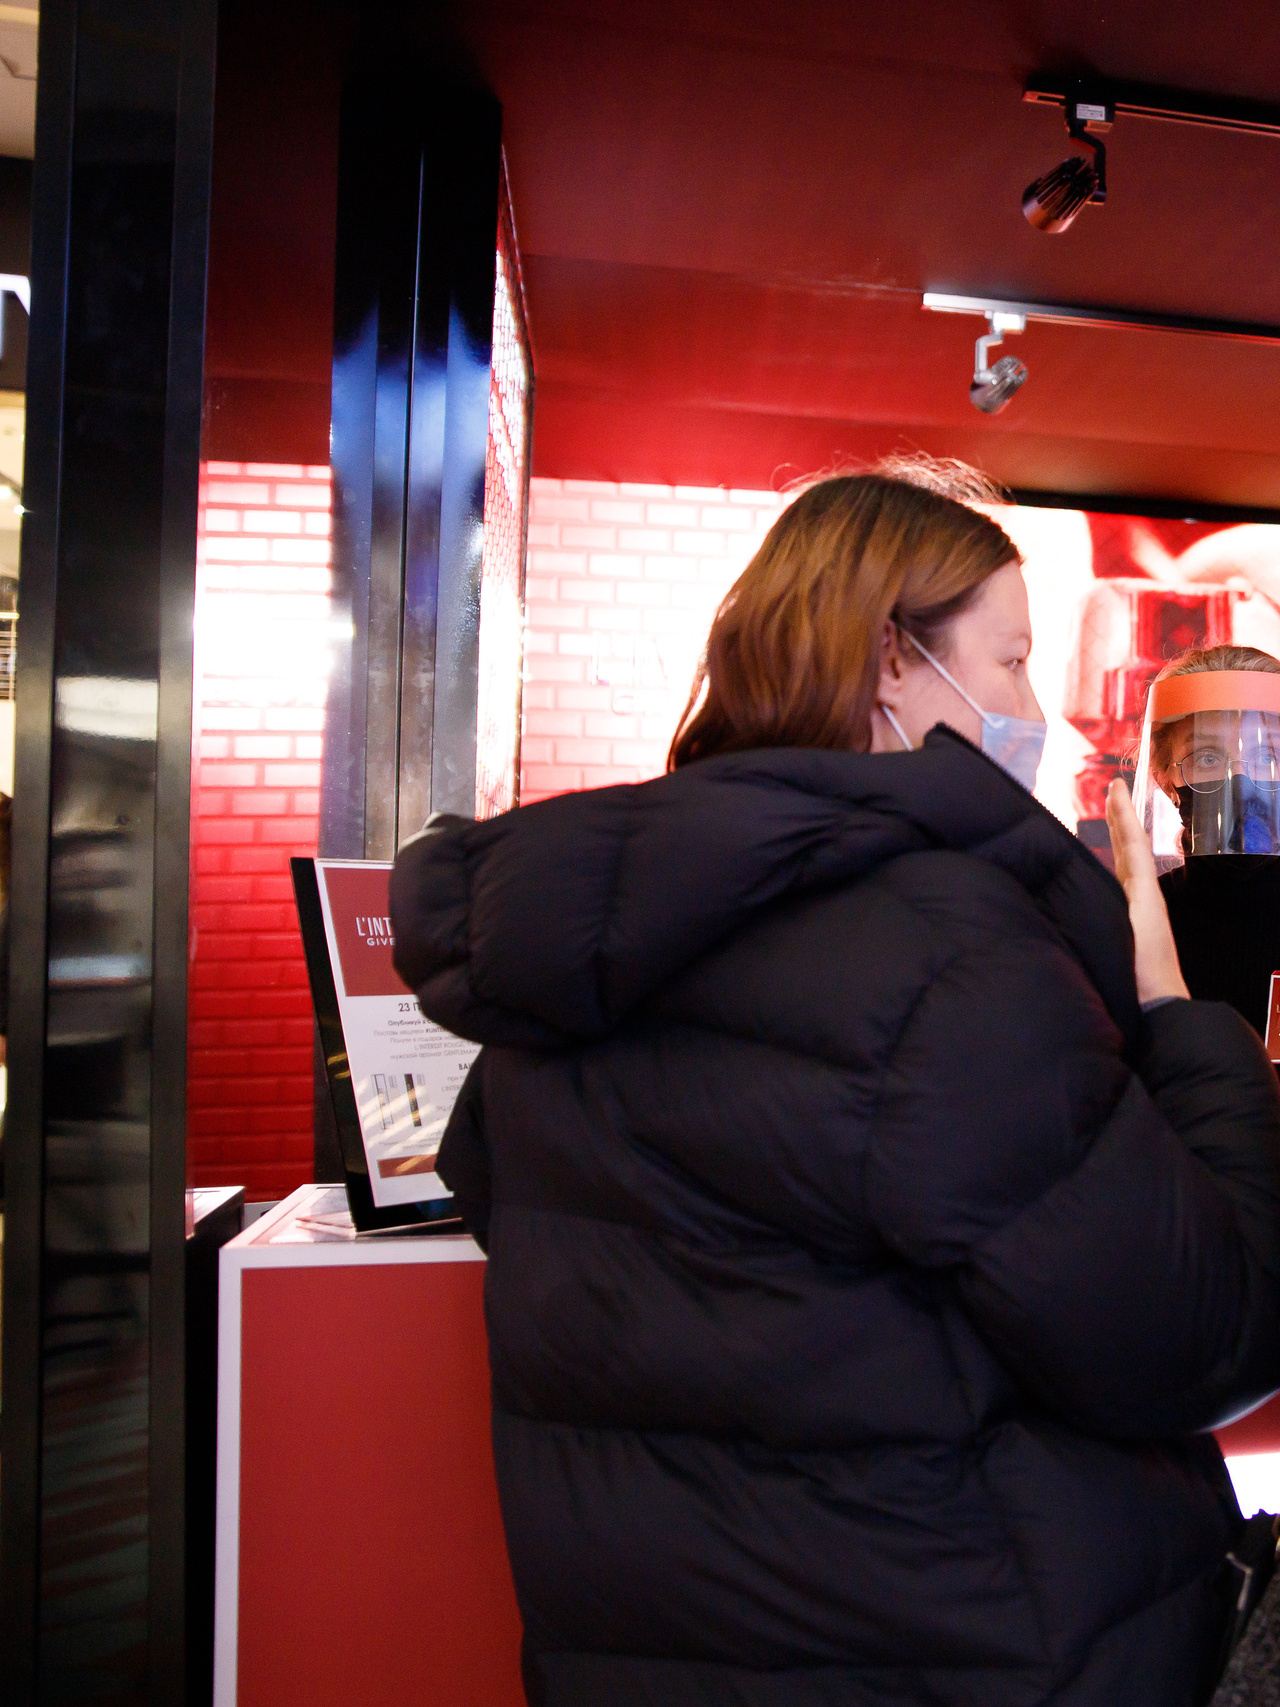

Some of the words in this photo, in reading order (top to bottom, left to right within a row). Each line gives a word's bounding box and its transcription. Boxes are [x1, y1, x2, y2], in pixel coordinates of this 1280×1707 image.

[355, 916, 392, 937] L'INT
[366, 937, 396, 947] GIVE
[398, 1003, 411, 1012] 23
